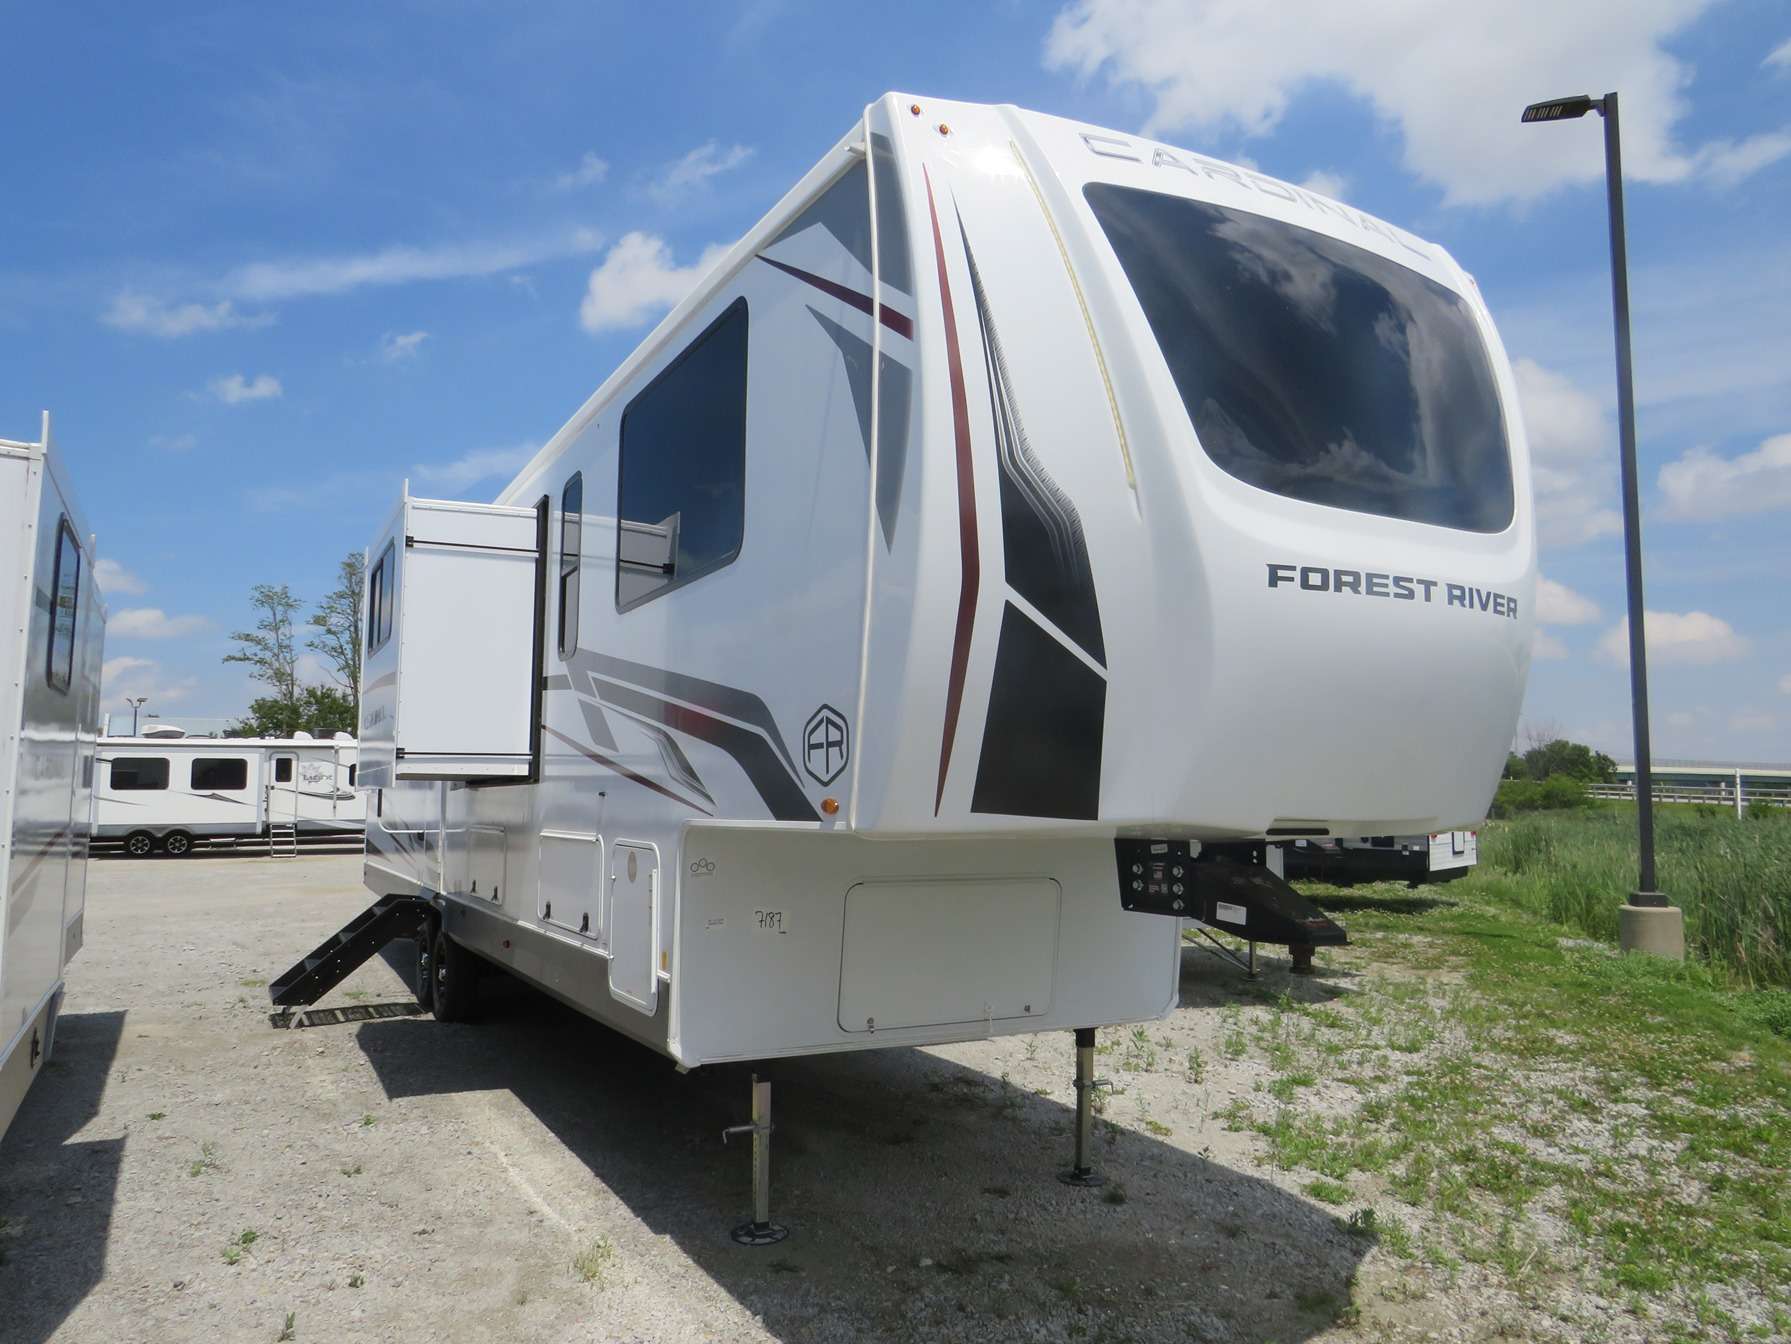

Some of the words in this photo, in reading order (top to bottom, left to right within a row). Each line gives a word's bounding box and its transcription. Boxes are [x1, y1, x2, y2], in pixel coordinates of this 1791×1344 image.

[1266, 563, 1438, 603] FOREST
[1445, 582, 1518, 620] RIVER
[755, 910, 782, 929] 7187
